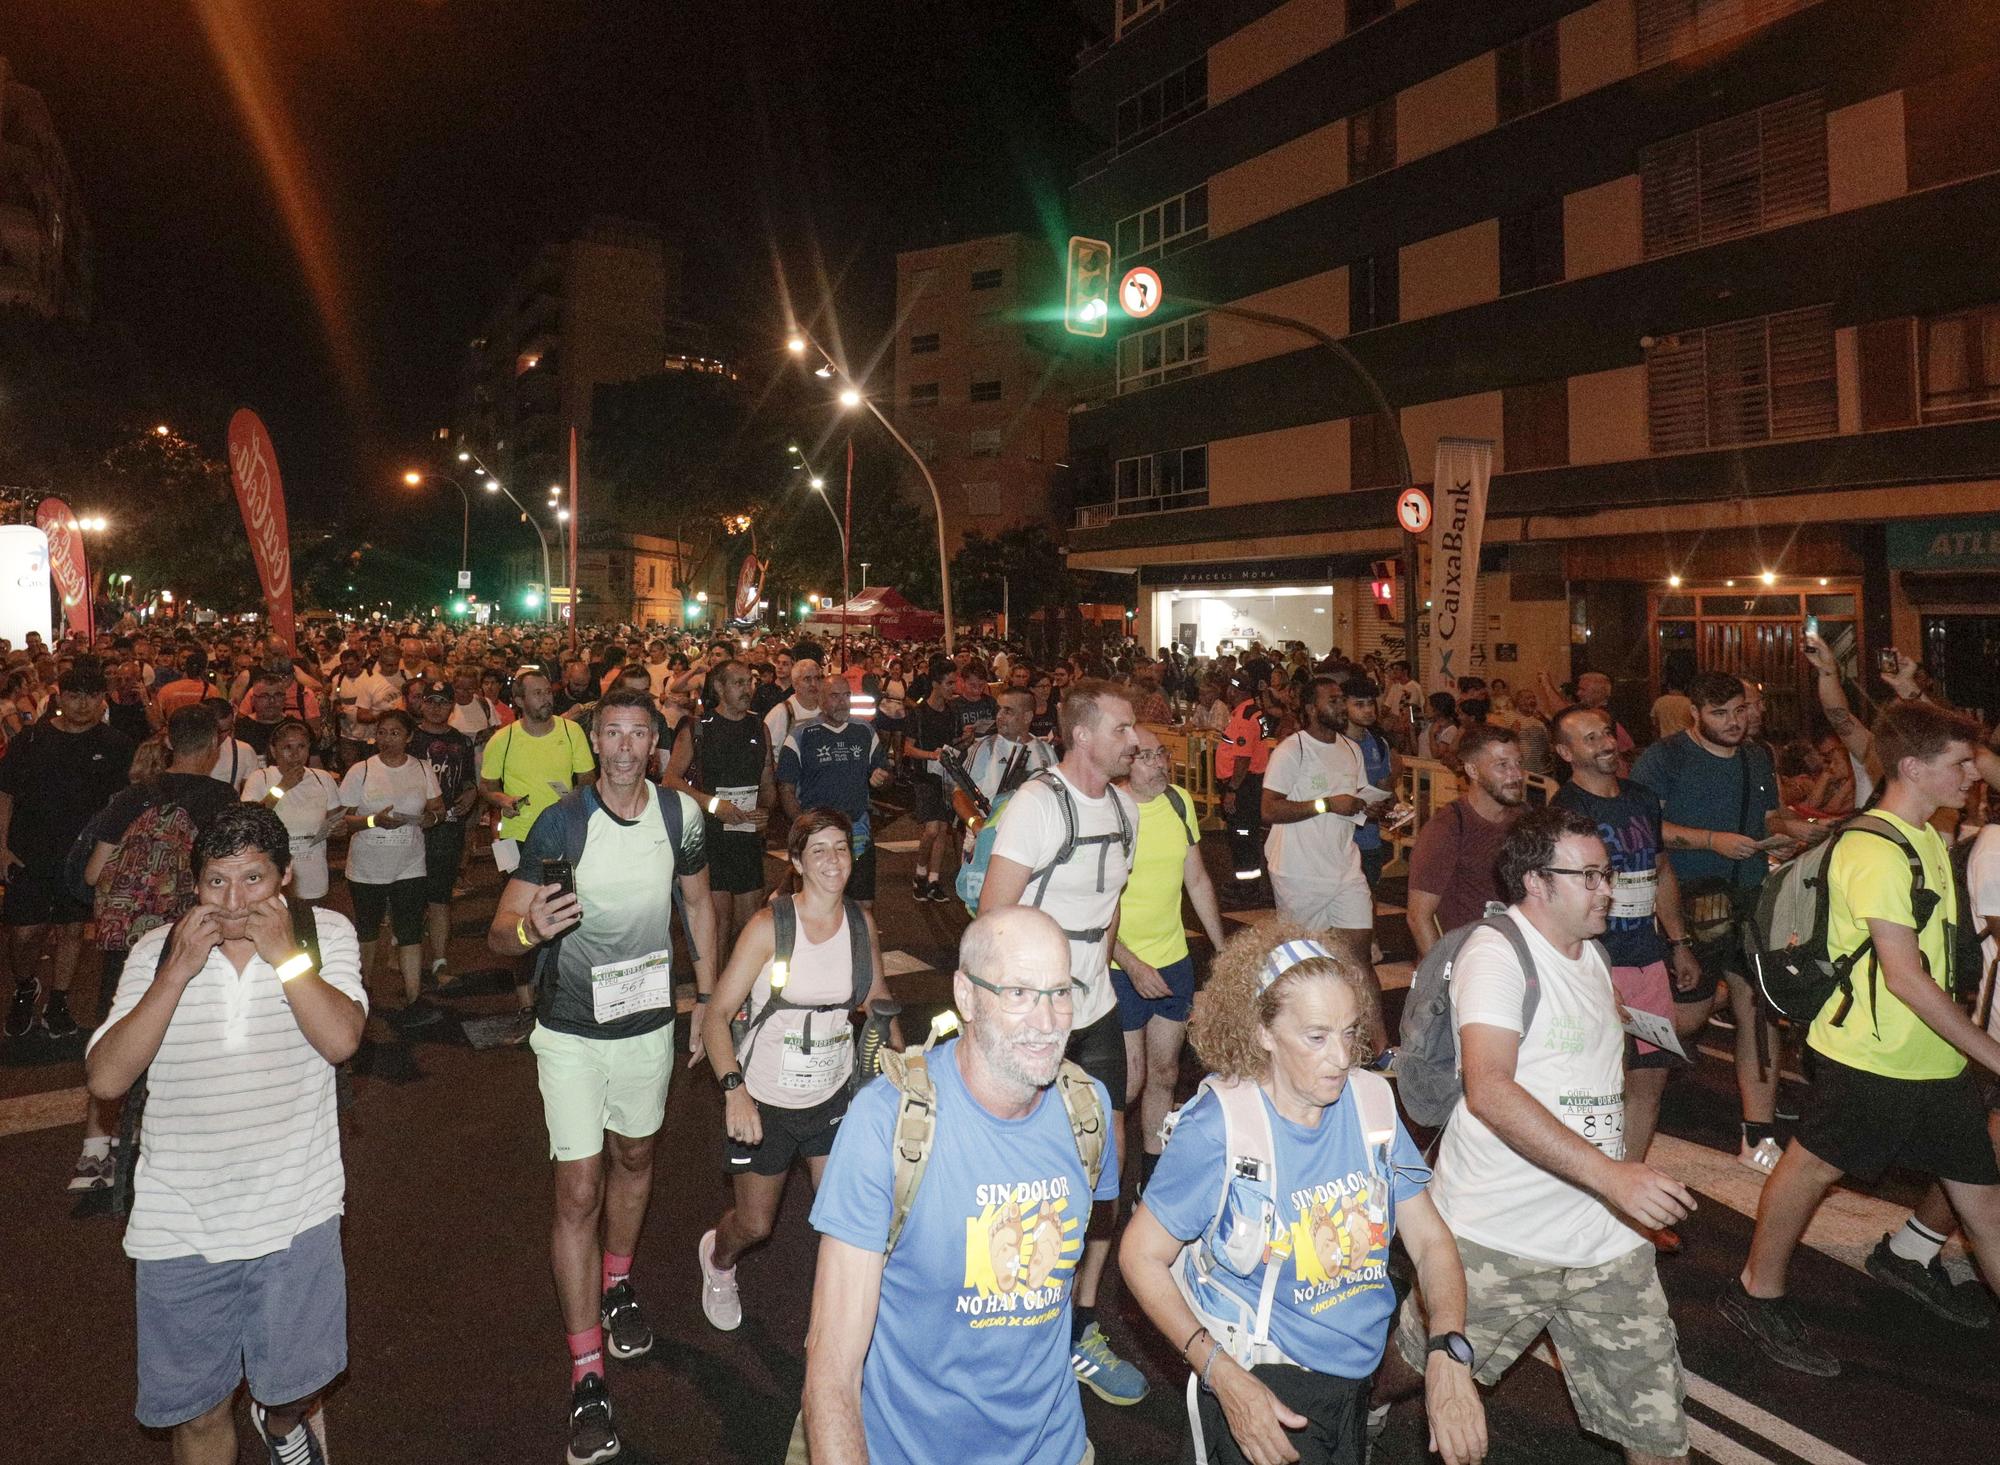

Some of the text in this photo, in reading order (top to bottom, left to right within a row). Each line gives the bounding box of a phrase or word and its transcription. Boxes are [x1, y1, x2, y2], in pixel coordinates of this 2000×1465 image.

[1437, 479, 1471, 641] CaixaBank
[1183, 570, 1275, 581] ARACELI MORA
[1744, 600, 1755, 610] 77
[618, 978, 644, 994] 567
[975, 1175, 1070, 1207] SIN DOLOR
[1291, 1170, 1368, 1211] SIN DOLOR
[955, 1285, 1064, 1315] NO HAY GLOR
[1293, 1285, 1315, 1305] NO
[1317, 1275, 1344, 1296] HAY
[1310, 1296, 1337, 1315] CAMINO
[1337, 1290, 1347, 1300] DE
[969, 1306, 1060, 1329] CAMINO DE SANTIAGO
